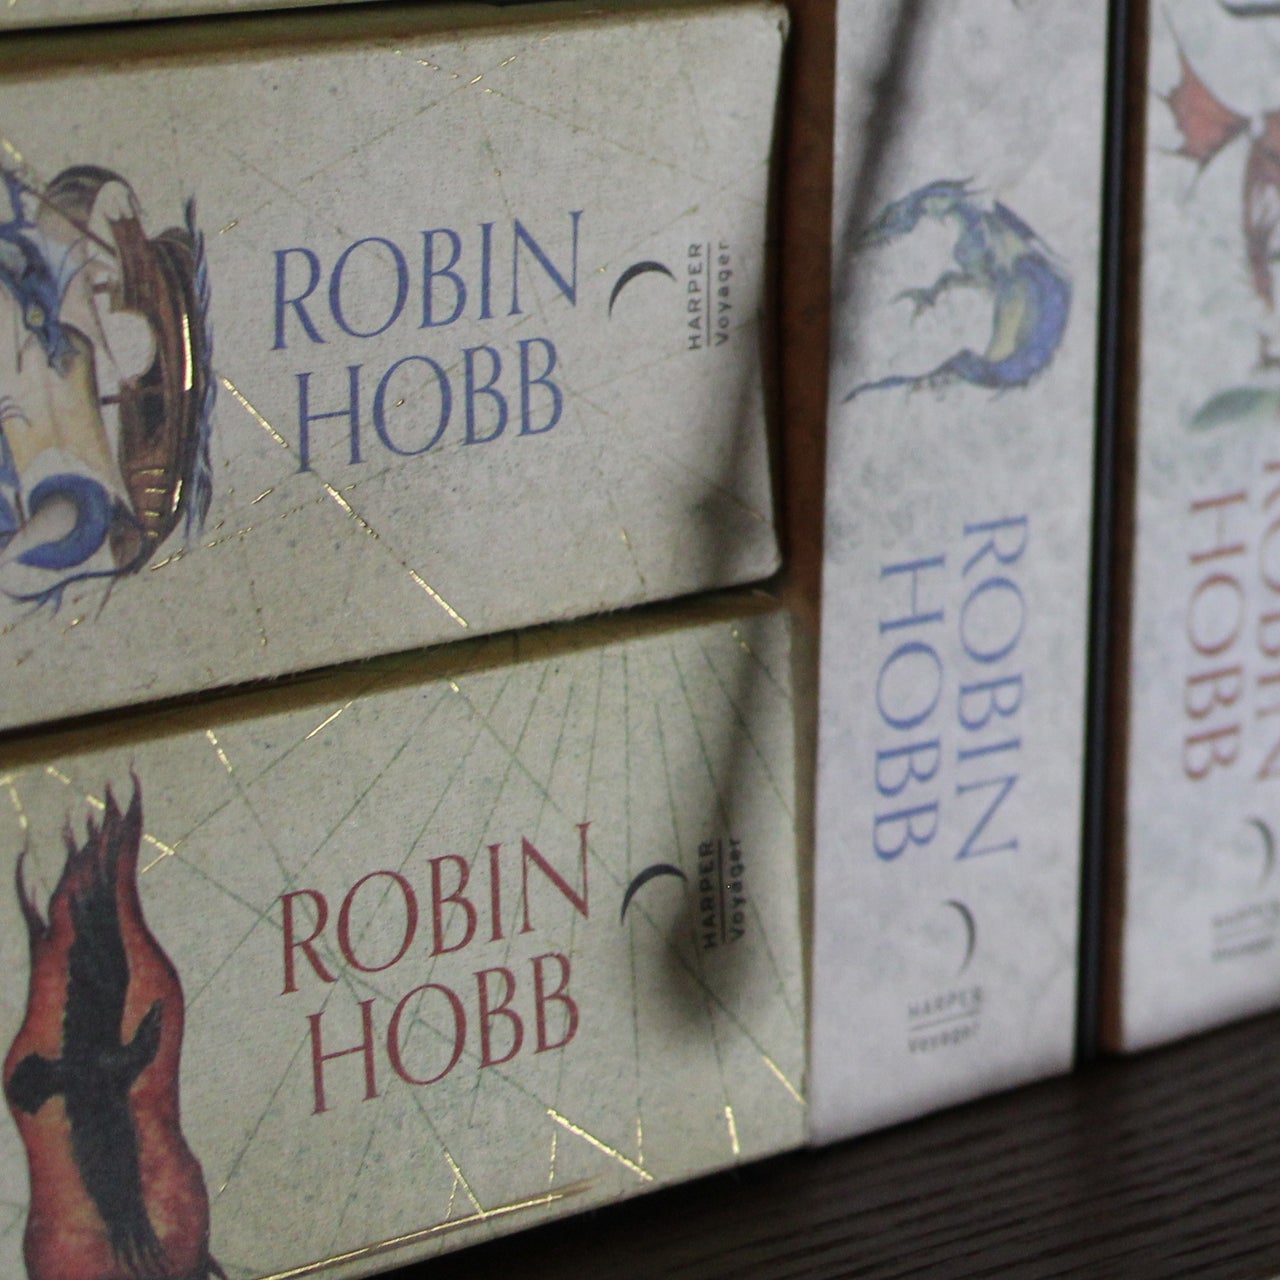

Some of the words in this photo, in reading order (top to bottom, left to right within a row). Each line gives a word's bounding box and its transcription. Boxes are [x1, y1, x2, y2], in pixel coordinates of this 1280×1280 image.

[270, 209, 585, 352] ROBIN
[686, 242, 703, 351] HARPER
[713, 237, 731, 346] Voyager
[295, 336, 565, 474] HOBB
[953, 514, 1029, 862] ROBIN
[1181, 491, 1249, 782] HOBB
[871, 552, 946, 865] HOBB
[278, 821, 592, 997] ROBIN
[698, 838, 718, 949] HARPER
[728, 837, 746, 938] Voyager
[304, 950, 582, 1117] HOBB
